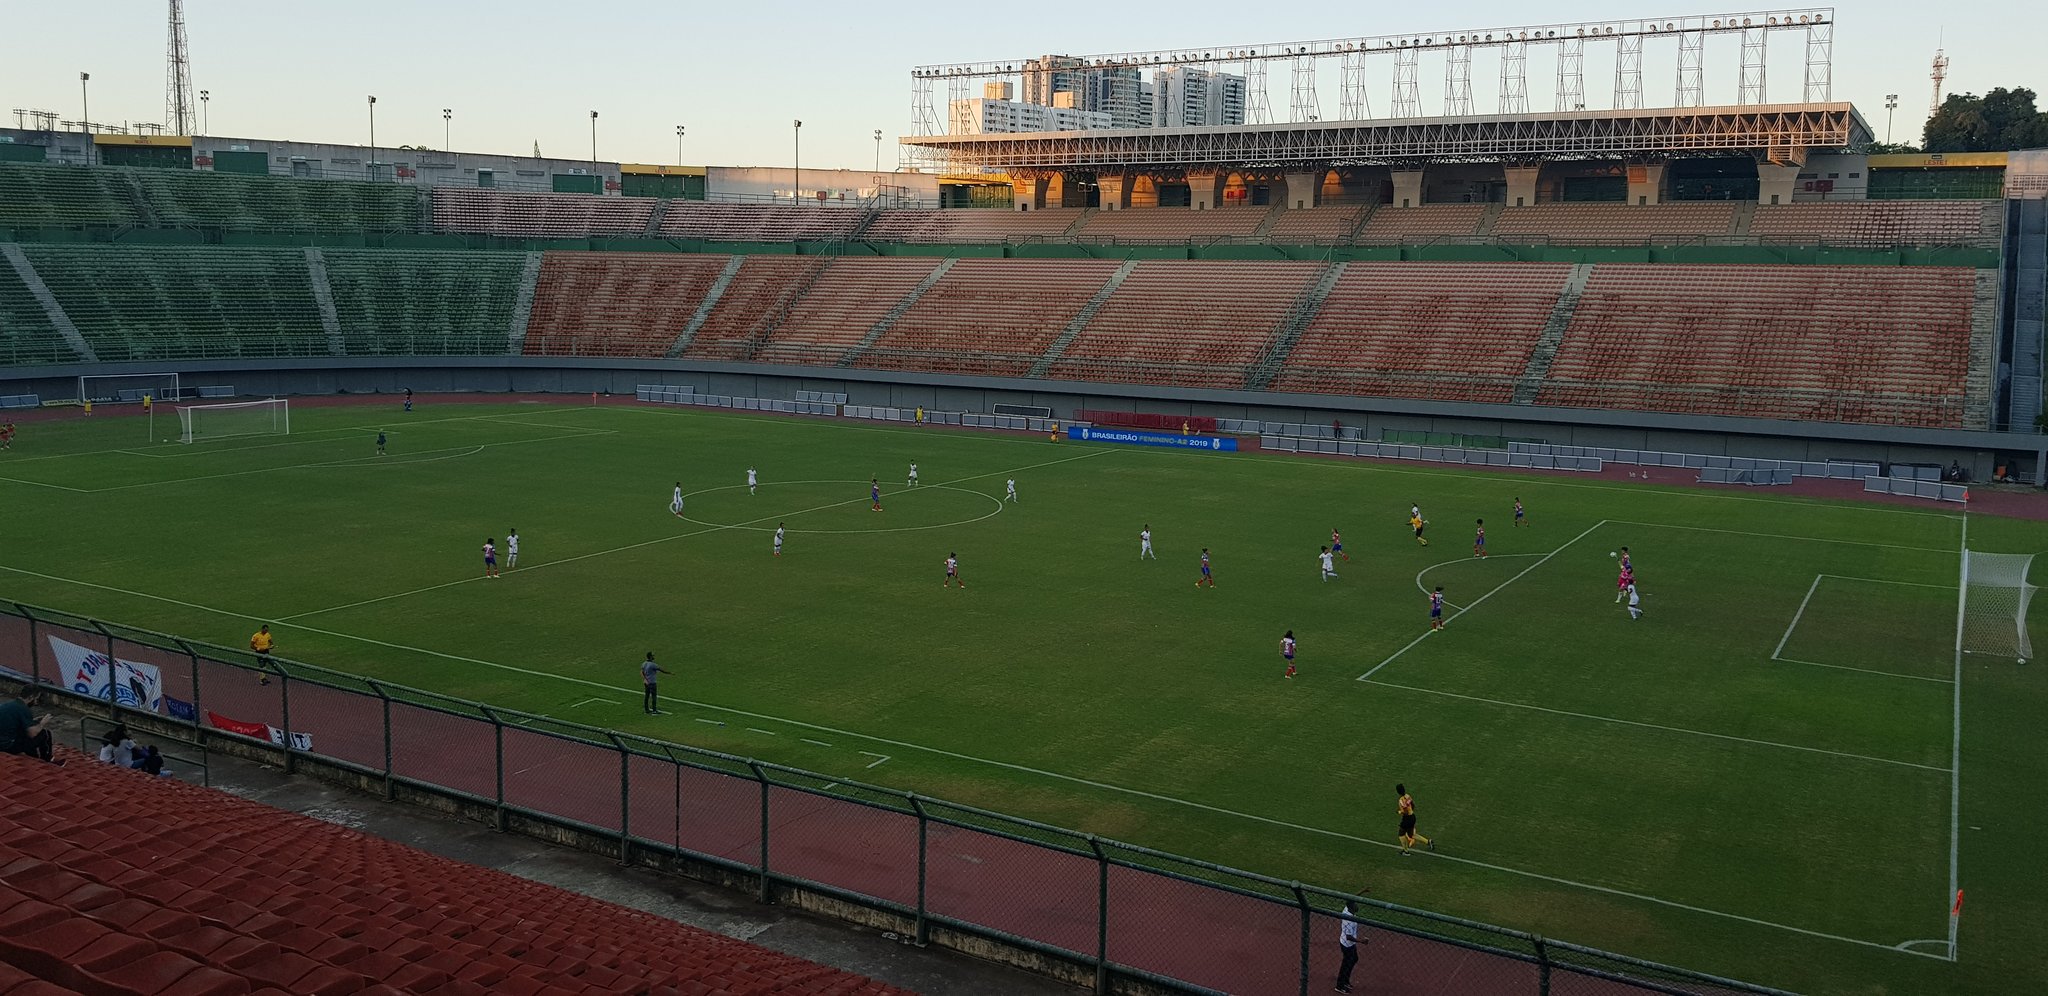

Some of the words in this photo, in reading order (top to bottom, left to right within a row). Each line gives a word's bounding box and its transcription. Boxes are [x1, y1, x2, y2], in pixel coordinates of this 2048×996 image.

[1091, 432, 1137, 442] BRASILEIRÃO
[1139, 435, 1187, 445] FEMININO-A2
[1189, 439, 1208, 447] 2019
